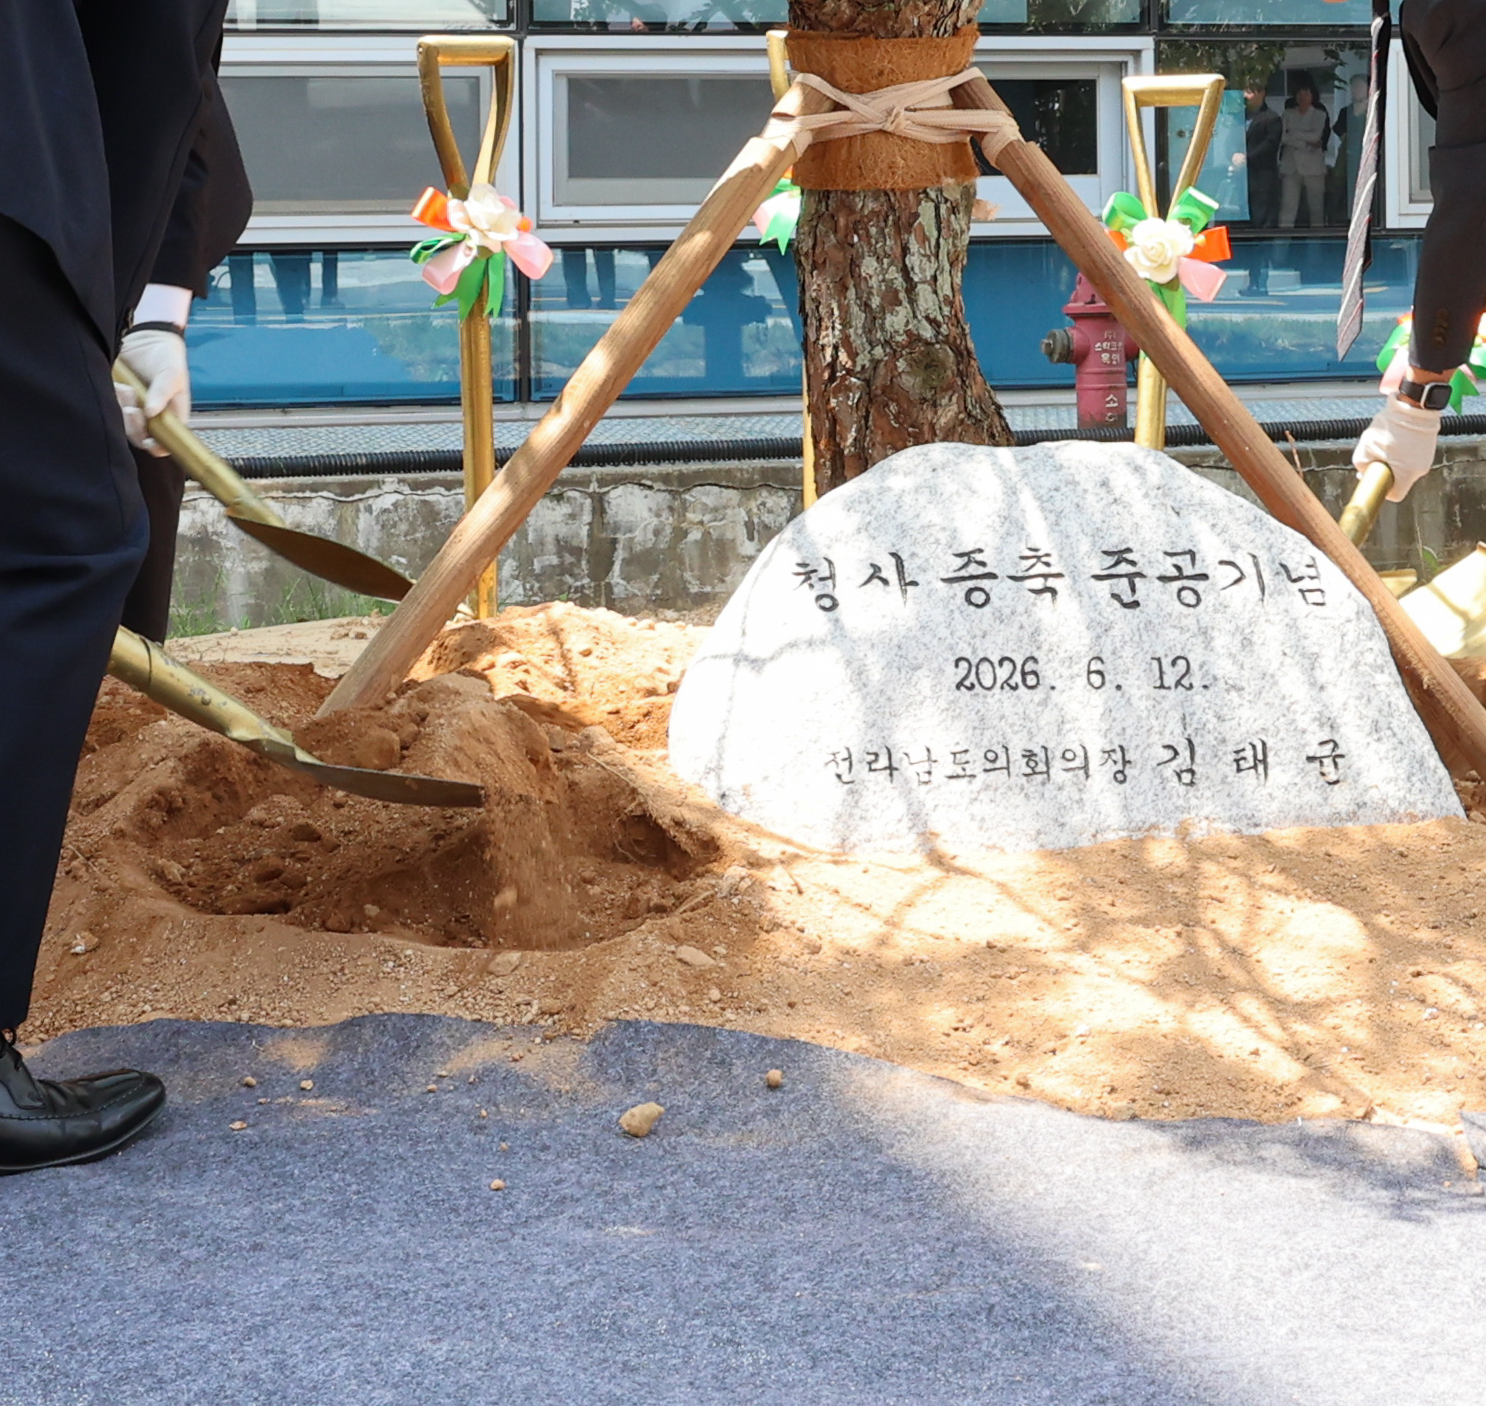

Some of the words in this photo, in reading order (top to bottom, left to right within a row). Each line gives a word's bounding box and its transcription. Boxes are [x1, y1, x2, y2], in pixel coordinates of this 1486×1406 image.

[791, 550, 920, 612] 청사
[939, 545, 1066, 608] 증축
[1090, 547, 1327, 609] 준공기념
[953, 655, 1056, 692] 2026.
[1086, 655, 1122, 692] 6.
[1150, 655, 1210, 692] 12.
[823, 743, 1133, 785] 전라남도의회의장
